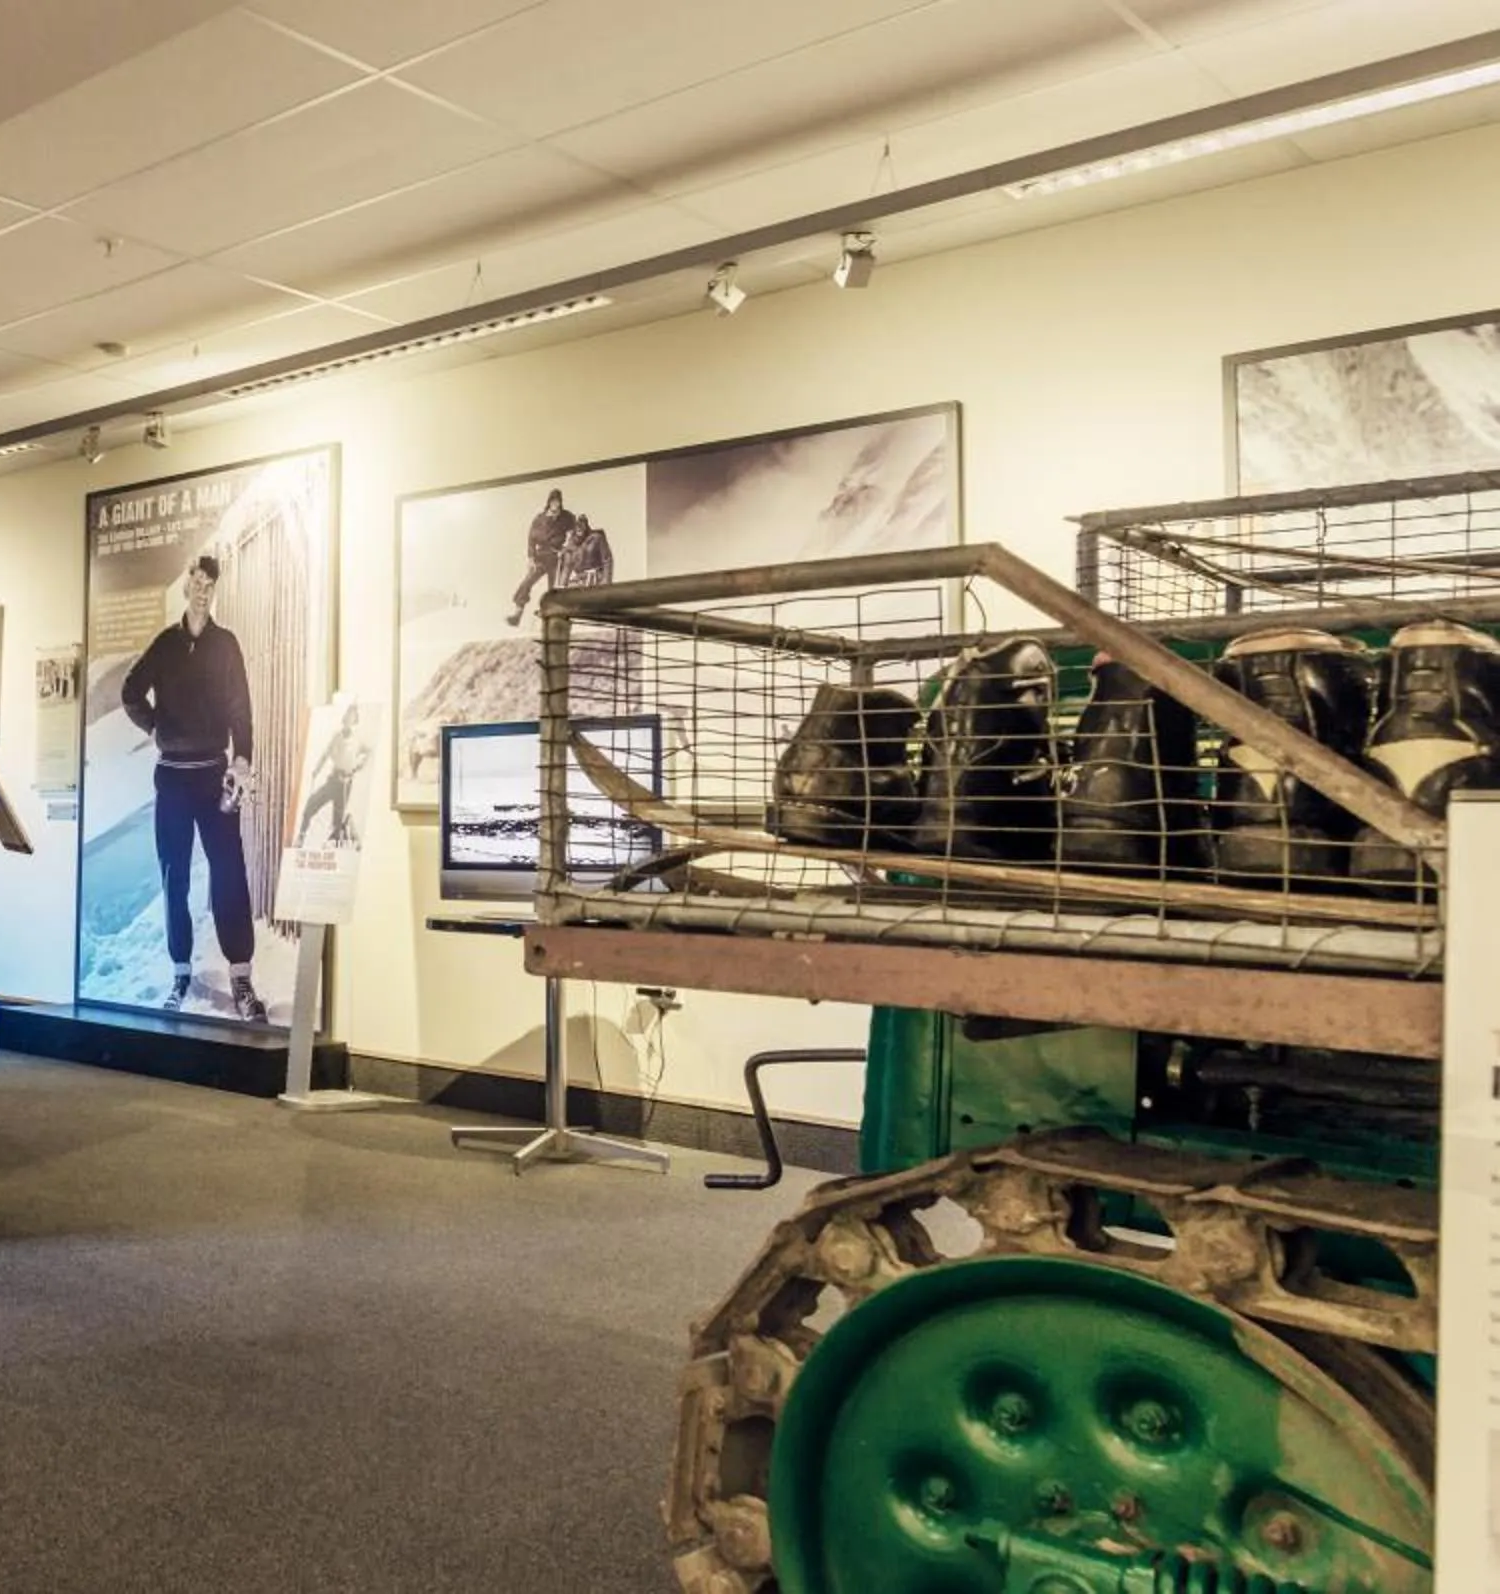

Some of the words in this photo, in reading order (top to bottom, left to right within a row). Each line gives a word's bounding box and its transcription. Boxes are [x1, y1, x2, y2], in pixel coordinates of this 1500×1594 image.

[98, 505, 109, 529] A
[111, 496, 155, 526] GIANT
[158, 493, 179, 517] OF
[181, 489, 192, 514] A
[196, 482, 232, 510] MAN
